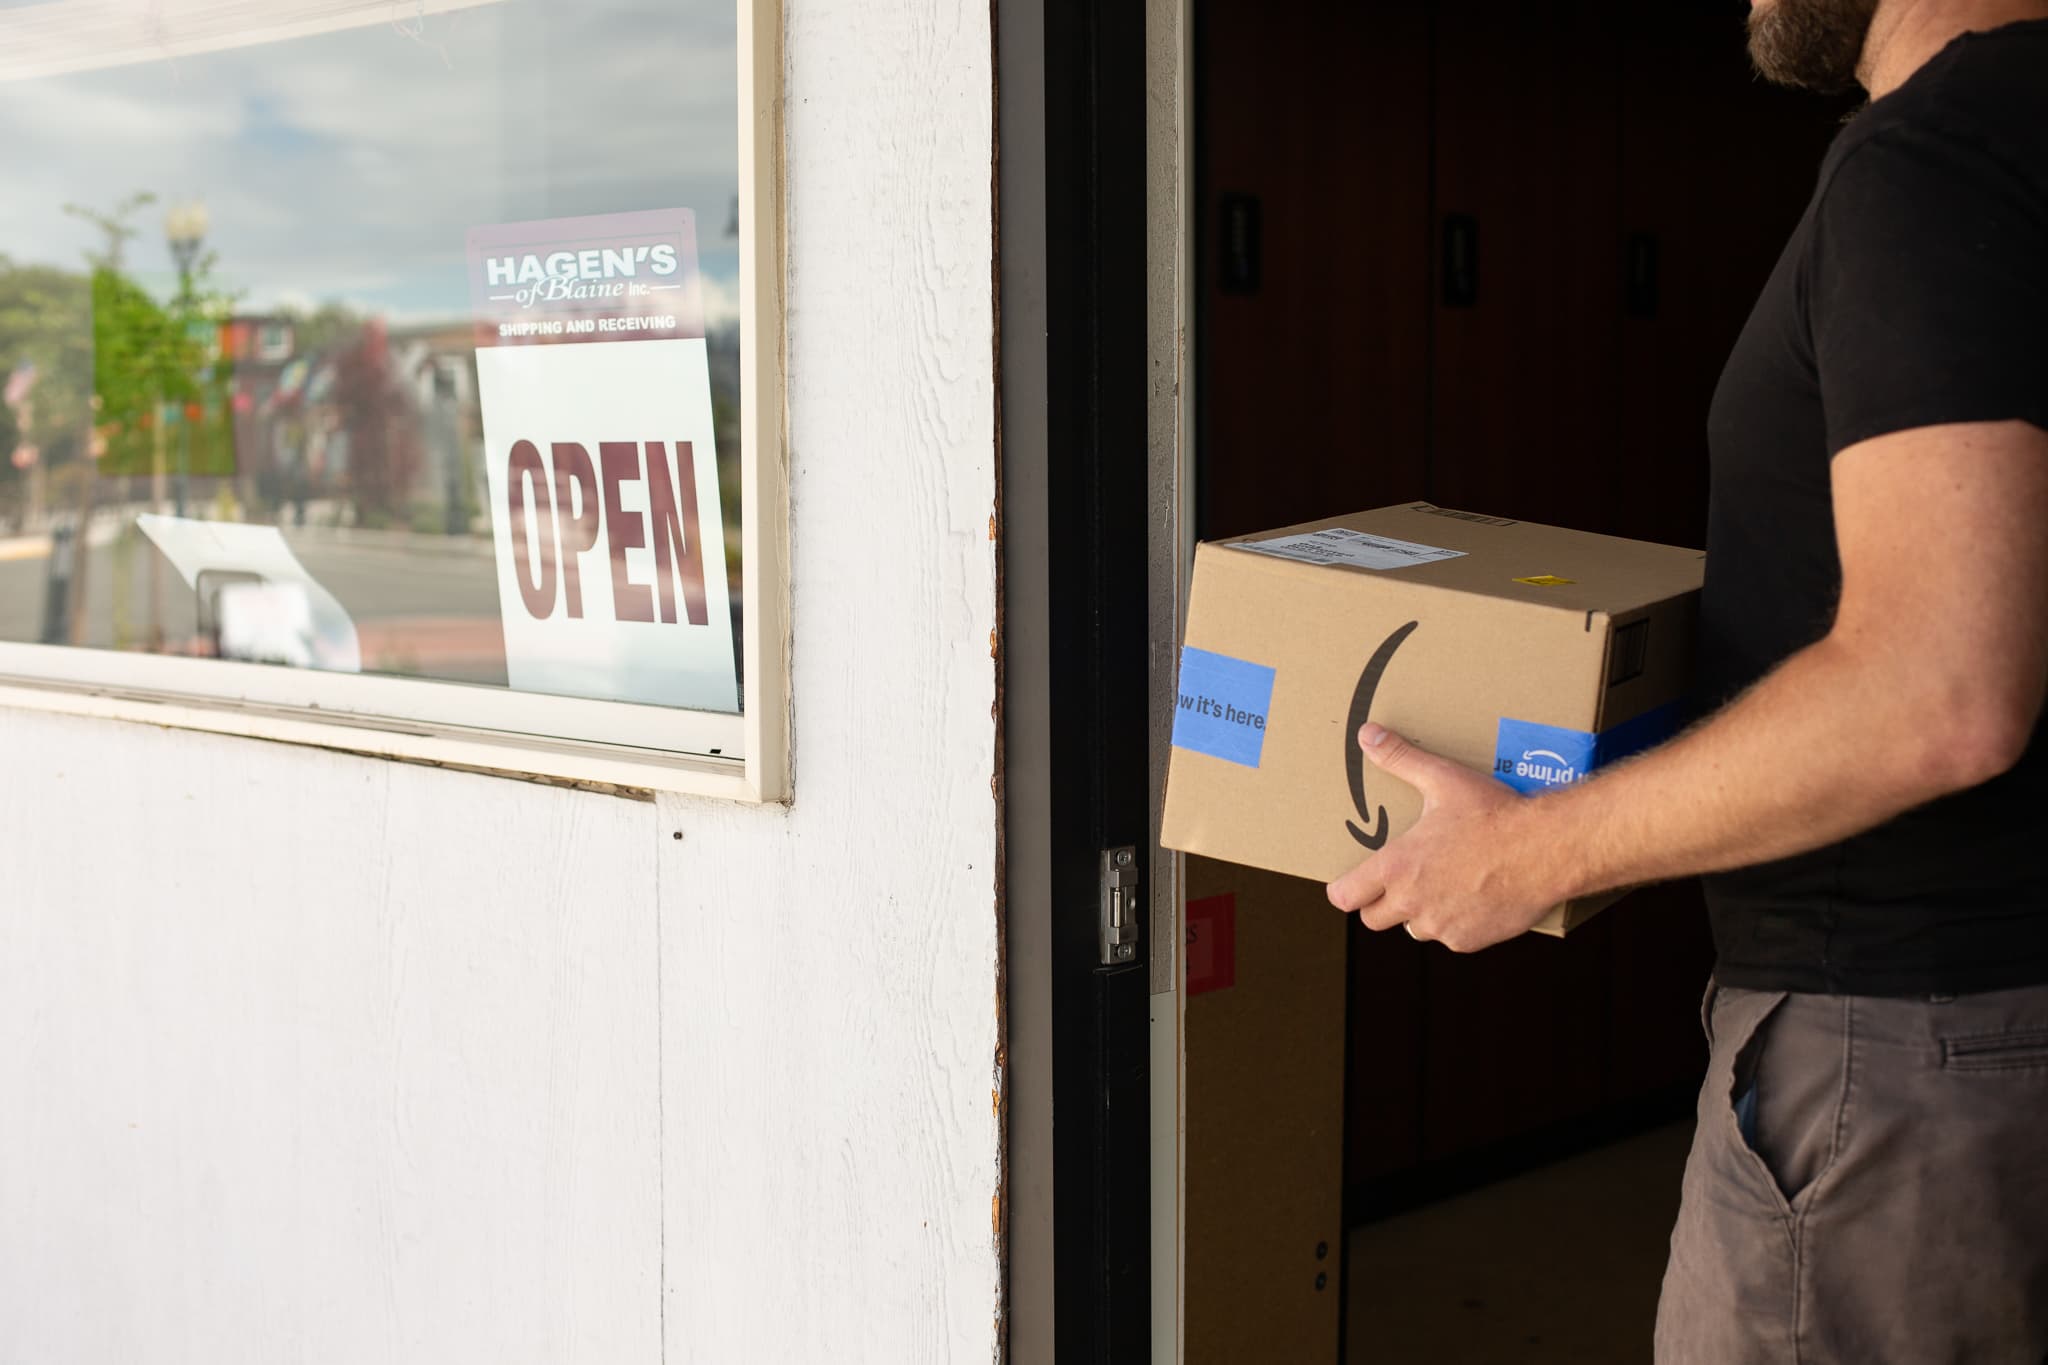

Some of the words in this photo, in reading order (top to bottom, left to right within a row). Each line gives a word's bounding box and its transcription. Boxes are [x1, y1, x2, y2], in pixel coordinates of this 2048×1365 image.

[486, 244, 678, 286] HAGEN'S
[515, 279, 541, 309] of
[537, 274, 625, 301] Blaine
[628, 281, 650, 297] Inc.
[499, 319, 562, 337] SHIPPING
[566, 318, 595, 334] AND
[599, 314, 677, 332] RECEIVING
[508, 439, 709, 626] OPEN
[1196, 695, 1223, 718] it's
[1516, 761, 1574, 785] prime
